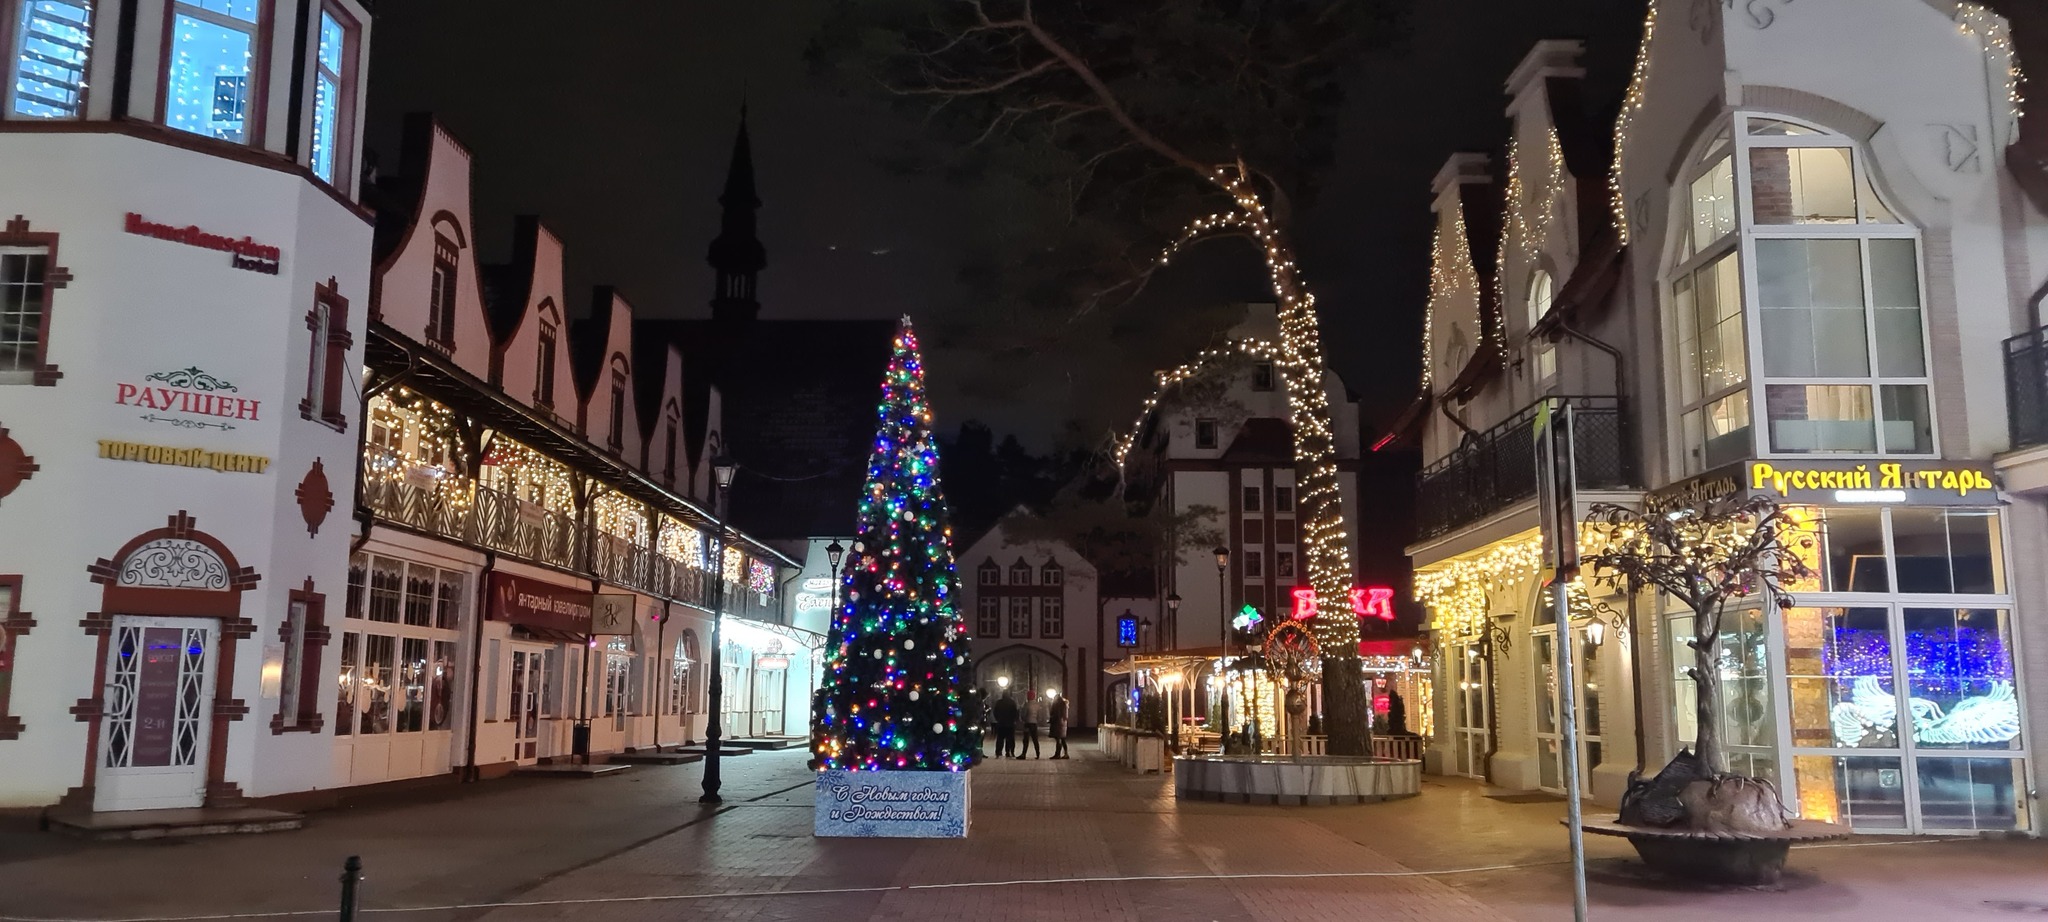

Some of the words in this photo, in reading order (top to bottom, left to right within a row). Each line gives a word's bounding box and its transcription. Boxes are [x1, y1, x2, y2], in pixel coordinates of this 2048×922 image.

[115, 383, 261, 421] РАУШЕН
[98, 440, 204, 469] ТОРГОВЫЙ
[210, 452, 271, 474] ЦЕНТР
[1753, 463, 1872, 497] Русский
[1879, 463, 1993, 497] Янтарь
[832, 786, 849, 801] С
[851, 786, 909, 803] Новым
[911, 788, 950, 802] годом
[830, 810, 840, 820] и
[842, 804, 943, 822] Рождеством!
